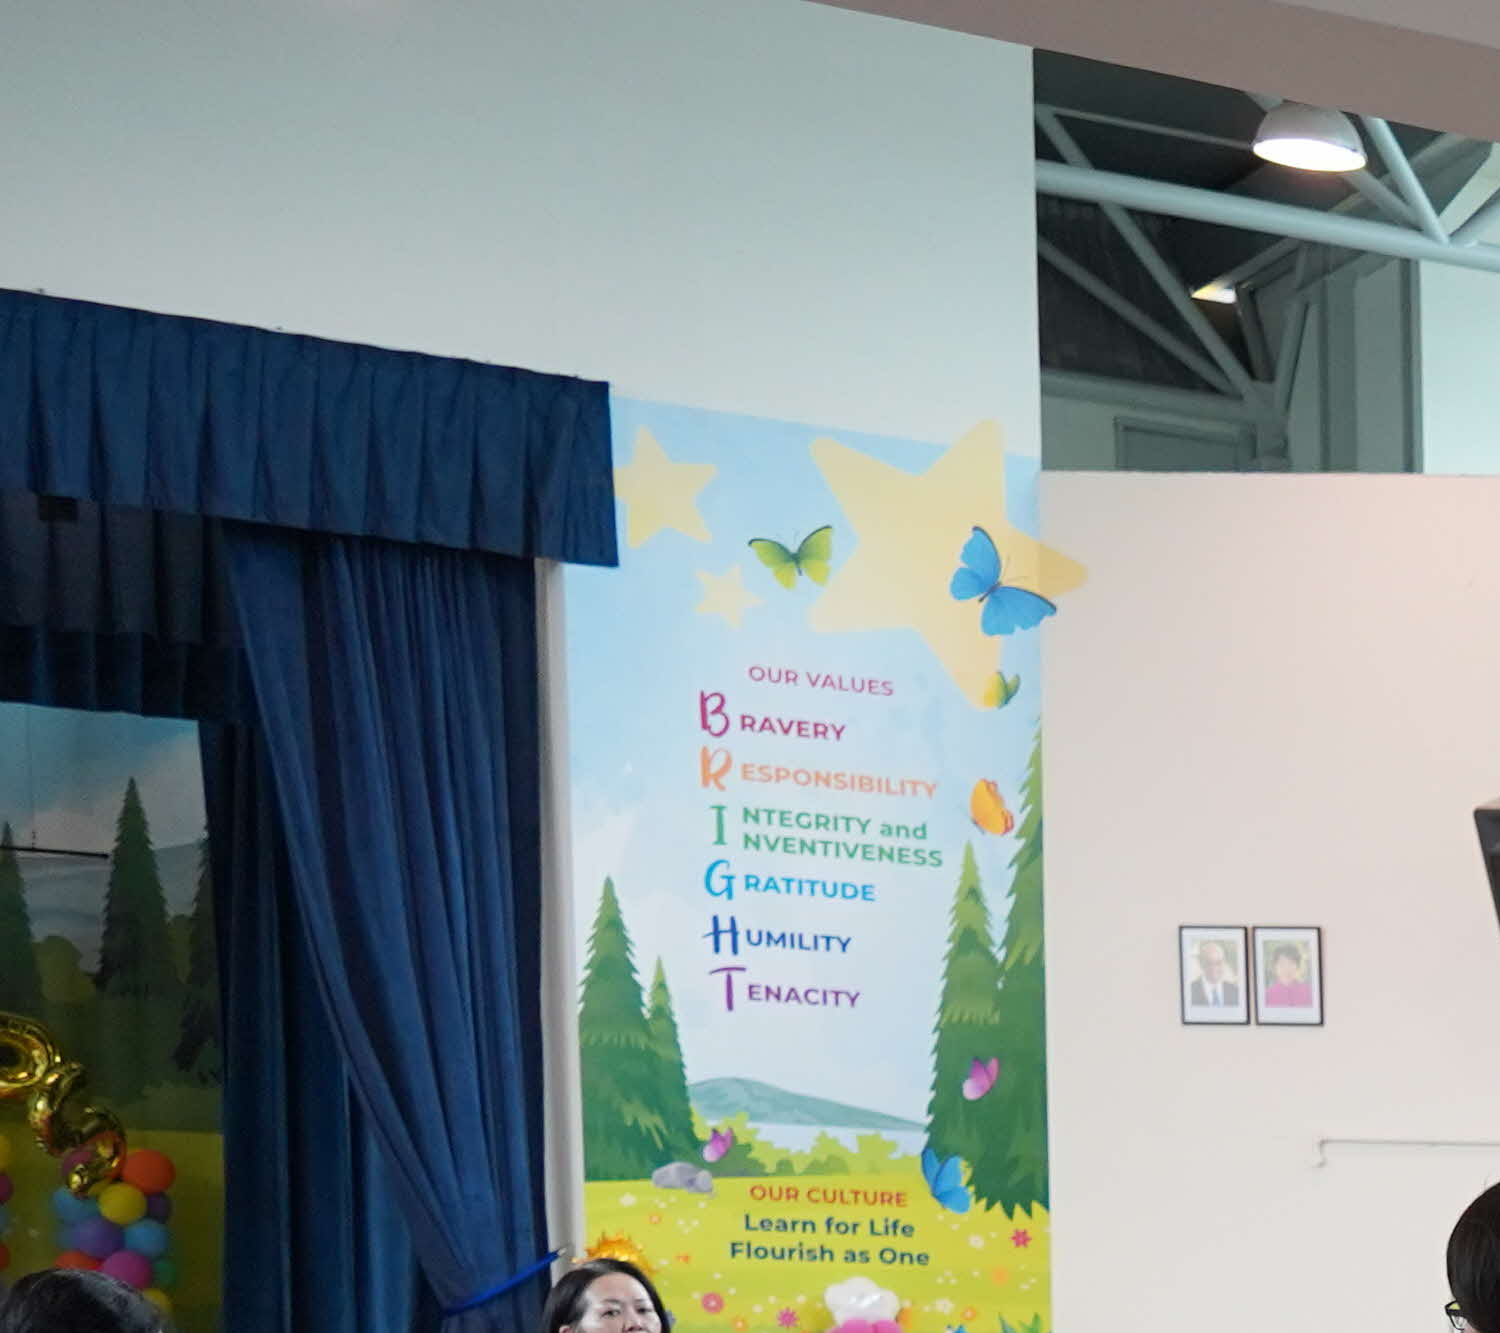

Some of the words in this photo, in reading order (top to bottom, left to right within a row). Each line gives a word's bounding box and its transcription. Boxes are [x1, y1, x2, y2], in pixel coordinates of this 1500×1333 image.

[748, 665, 799, 686] OUR
[806, 672, 895, 697] VALUES
[880, 821, 928, 840] and
[749, 1185, 800, 1202] OUR
[806, 1188, 909, 1209] CULTURE
[744, 1213, 817, 1235] Learn
[825, 1216, 861, 1235] for
[870, 1217, 916, 1238] Life
[730, 1241, 835, 1262] Flourish
[843, 1248, 871, 1264] as
[878, 1246, 930, 1266] One
